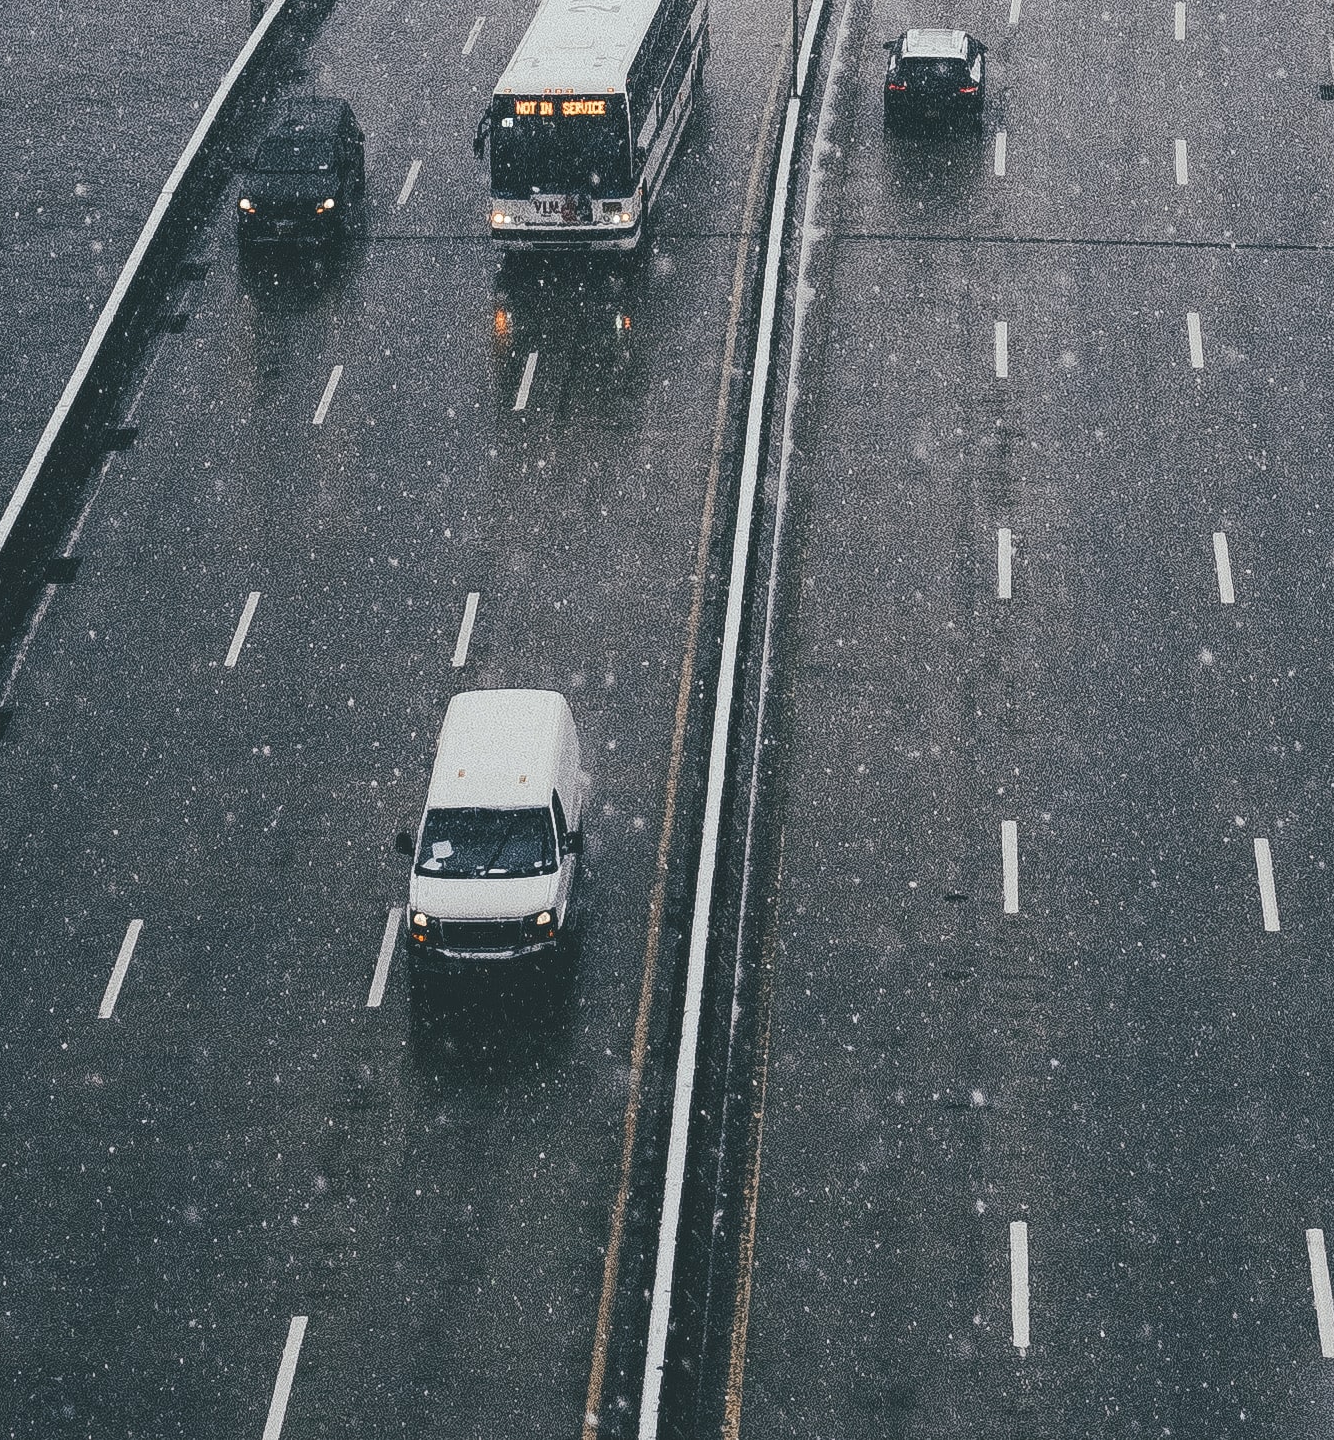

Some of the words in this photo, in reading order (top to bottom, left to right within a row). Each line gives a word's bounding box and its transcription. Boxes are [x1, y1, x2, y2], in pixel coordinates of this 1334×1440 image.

[515, 100, 538, 116] NOT
[540, 100, 554, 116] IN
[561, 99, 607, 116] SERVICE
